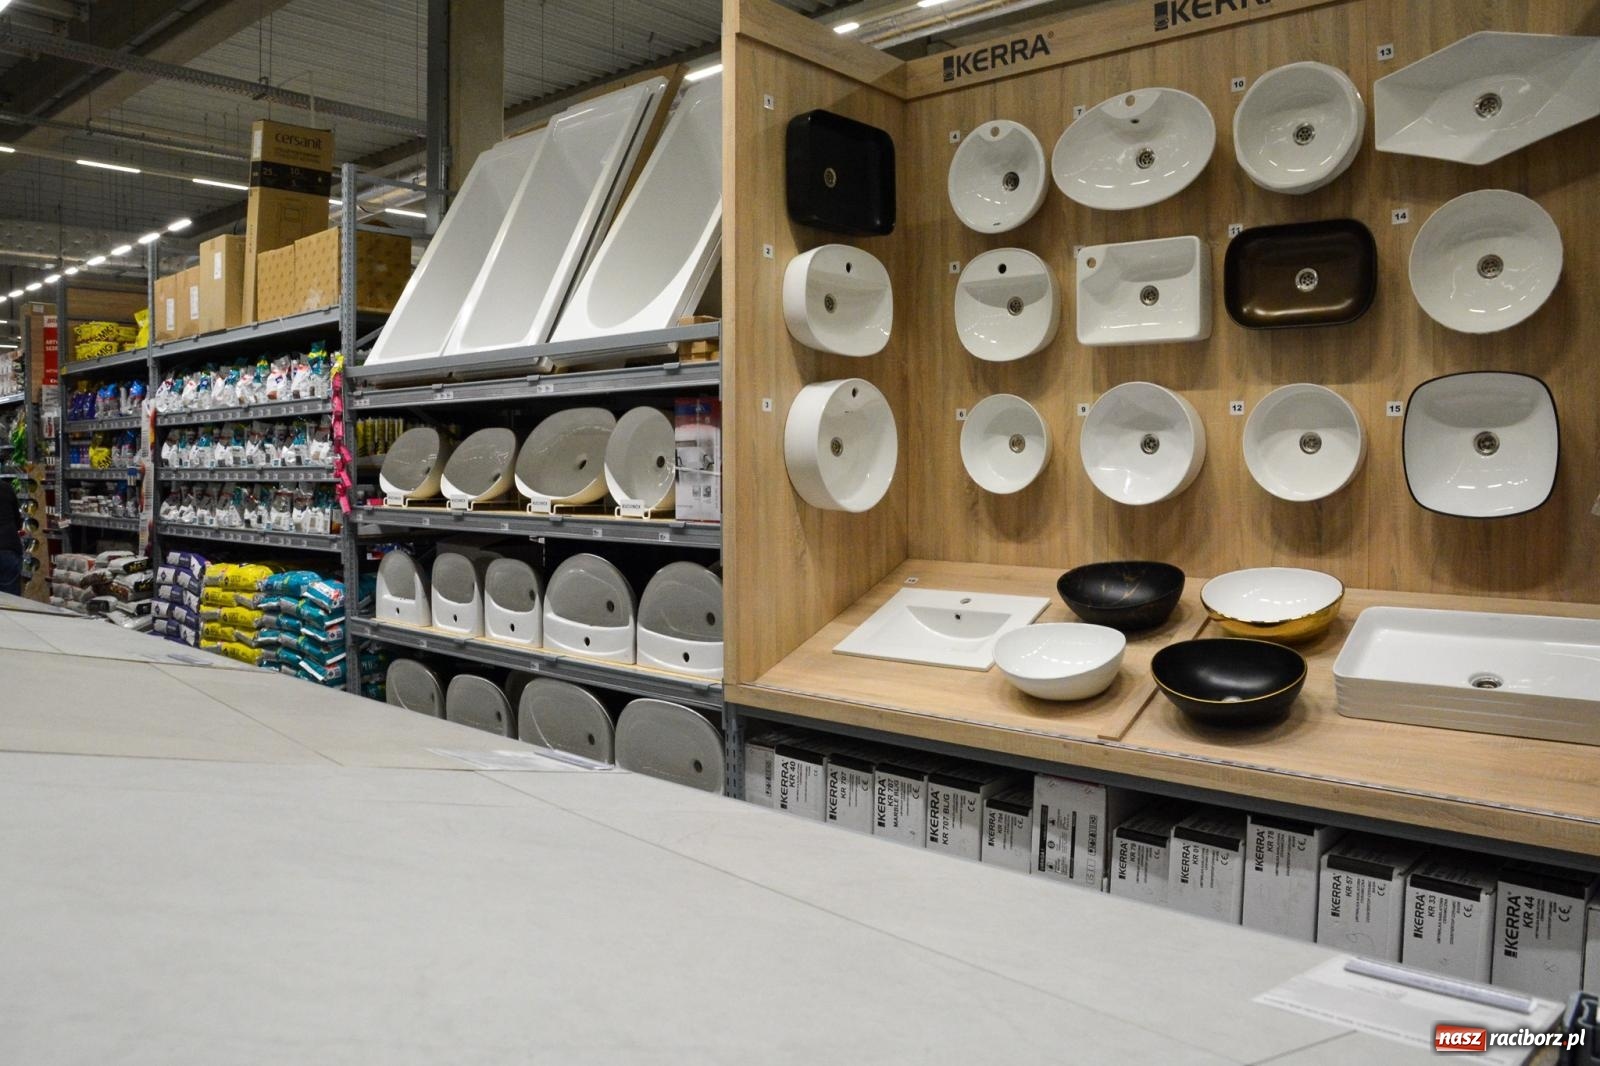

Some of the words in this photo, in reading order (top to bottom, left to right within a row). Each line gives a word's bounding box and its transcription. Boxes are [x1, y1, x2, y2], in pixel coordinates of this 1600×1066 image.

[1379, 47, 1392, 57] 13
[1233, 79, 1244, 89] 10
[274, 132, 324, 150] cersanit
[1395, 211, 1407, 221] 14
[1232, 404, 1243, 412] 12
[1389, 404, 1401, 413] 15
[780, 761, 789, 804] KERRA
[829, 771, 838, 815] KERRA
[877, 779, 887, 822] KERRA
[930, 791, 940, 836] KERRA
[988, 812, 996, 842] KERRA
[1119, 842, 1129, 875] KERRA
[1181, 845, 1192, 879] KERRA
[1255, 830, 1265, 867] KERRA
[1330, 875, 1342, 912] KERRA
[1413, 894, 1426, 933] KERRA
[1504, 895, 1521, 951] KERRA
